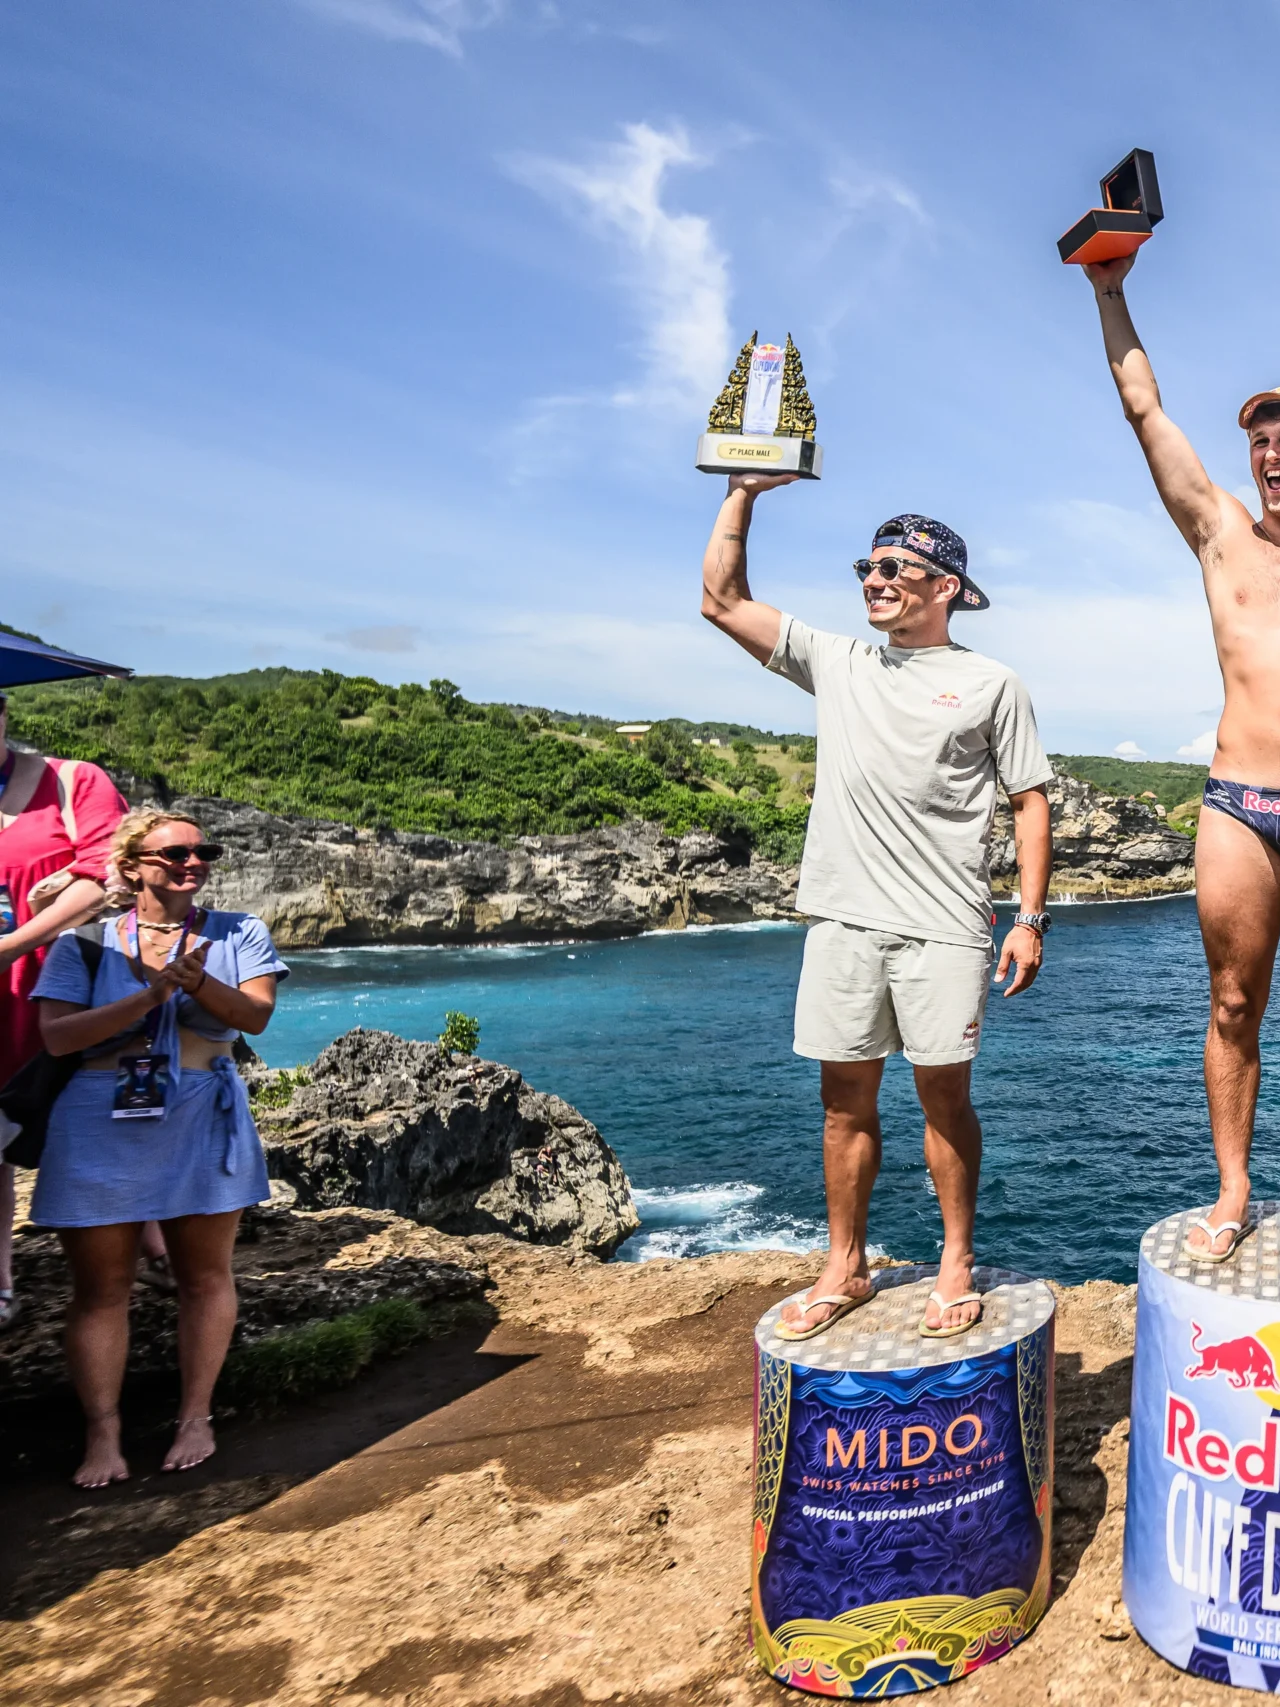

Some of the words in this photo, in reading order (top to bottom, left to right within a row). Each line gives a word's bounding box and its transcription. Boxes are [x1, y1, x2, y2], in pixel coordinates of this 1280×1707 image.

[738, 448, 755, 456] PLACE
[756, 449, 771, 457] MALE
[826, 1414, 983, 1470] MIDO
[1166, 1396, 1279, 1488] Red
[801, 1475, 842, 1492] SWISS
[849, 1478, 921, 1492] WATCHES
[927, 1466, 972, 1486] SINCE
[801, 1504, 855, 1522] OFFICIAL
[857, 1499, 953, 1522] PERFORMANCE
[954, 1480, 1005, 1506] PARTNER
[1165, 1472, 1253, 1605] CLIFF
[1195, 1605, 1248, 1638] WORLD
[1232, 1640, 1257, 1657] BALI
